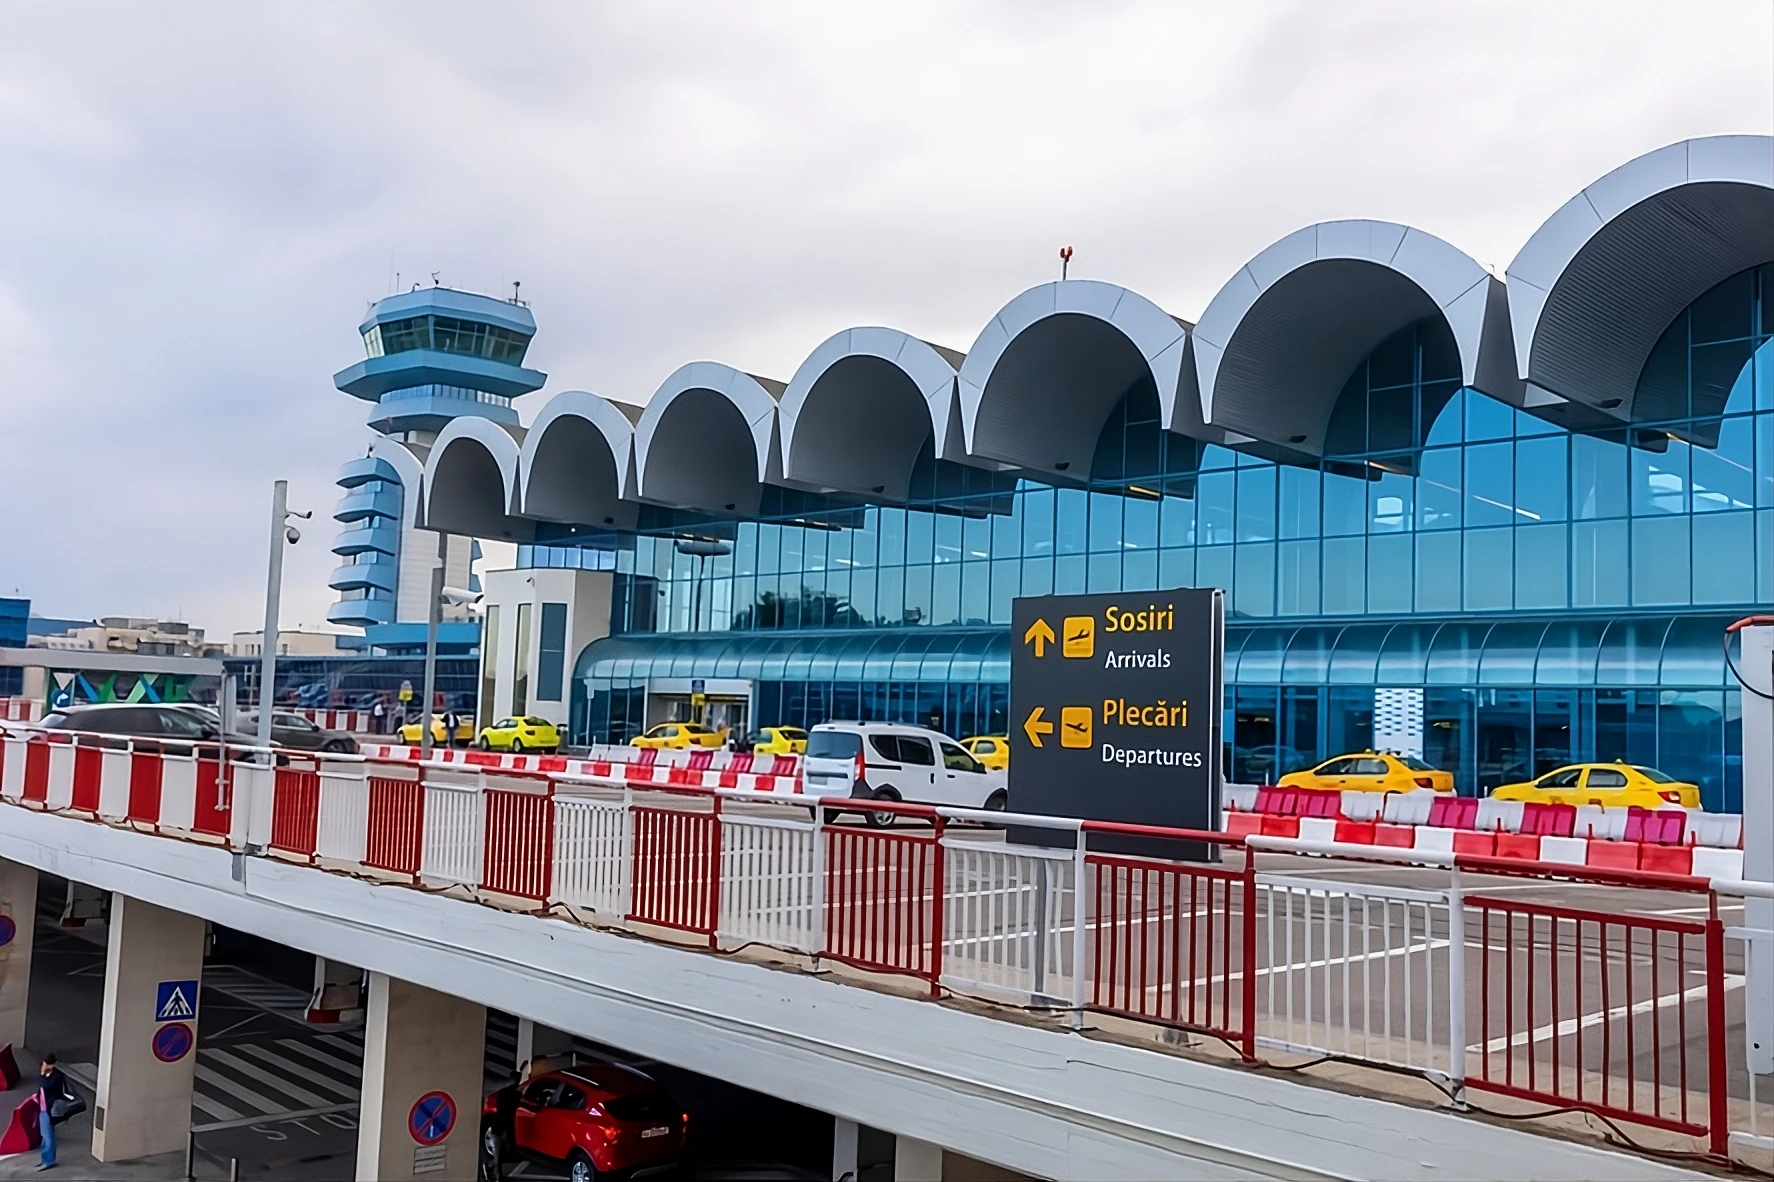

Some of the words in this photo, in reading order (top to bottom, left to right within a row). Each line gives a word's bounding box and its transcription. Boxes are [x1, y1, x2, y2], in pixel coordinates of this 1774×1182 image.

[1105, 604, 1173, 632] Sosiri
[1105, 650, 1171, 668] Arrivals
[1103, 699, 1188, 727] Plecări
[1102, 744, 1202, 767] Departures
[249, 1111, 358, 1141] STO
